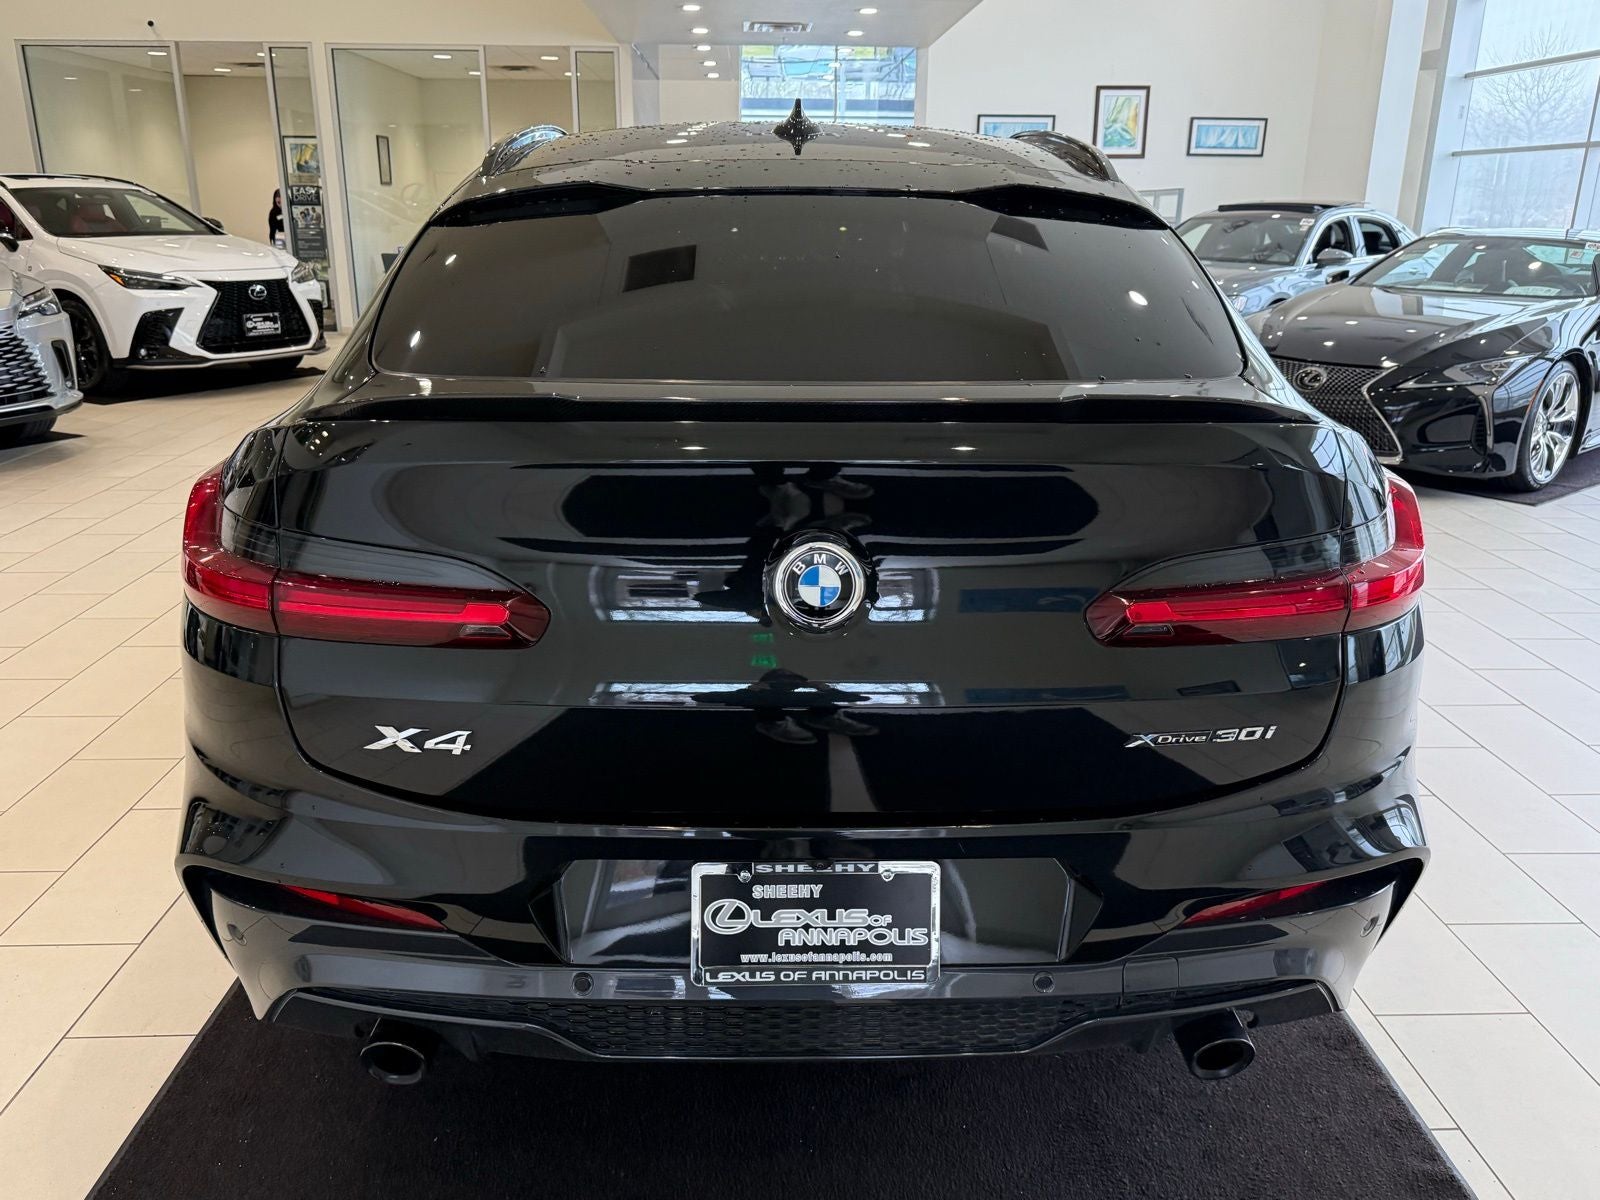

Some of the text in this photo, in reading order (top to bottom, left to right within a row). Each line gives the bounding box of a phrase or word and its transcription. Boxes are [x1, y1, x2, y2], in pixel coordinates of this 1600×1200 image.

[292, 186, 317, 195] EASY
[293, 194, 318, 202] DRIVE
[792, 553, 849, 576] BMW
[362, 724, 473, 756] X4
[1212, 724, 1278, 743] 30i
[752, 884, 823, 899] SHEEHY
[751, 909, 870, 928] LEXUS
[778, 928, 929, 947] ANNAPOLIS
[740, 952, 893, 964] www.lexusofannapolis.com
[705, 971, 925, 982] LEXUS OF ANNAPOLIS
